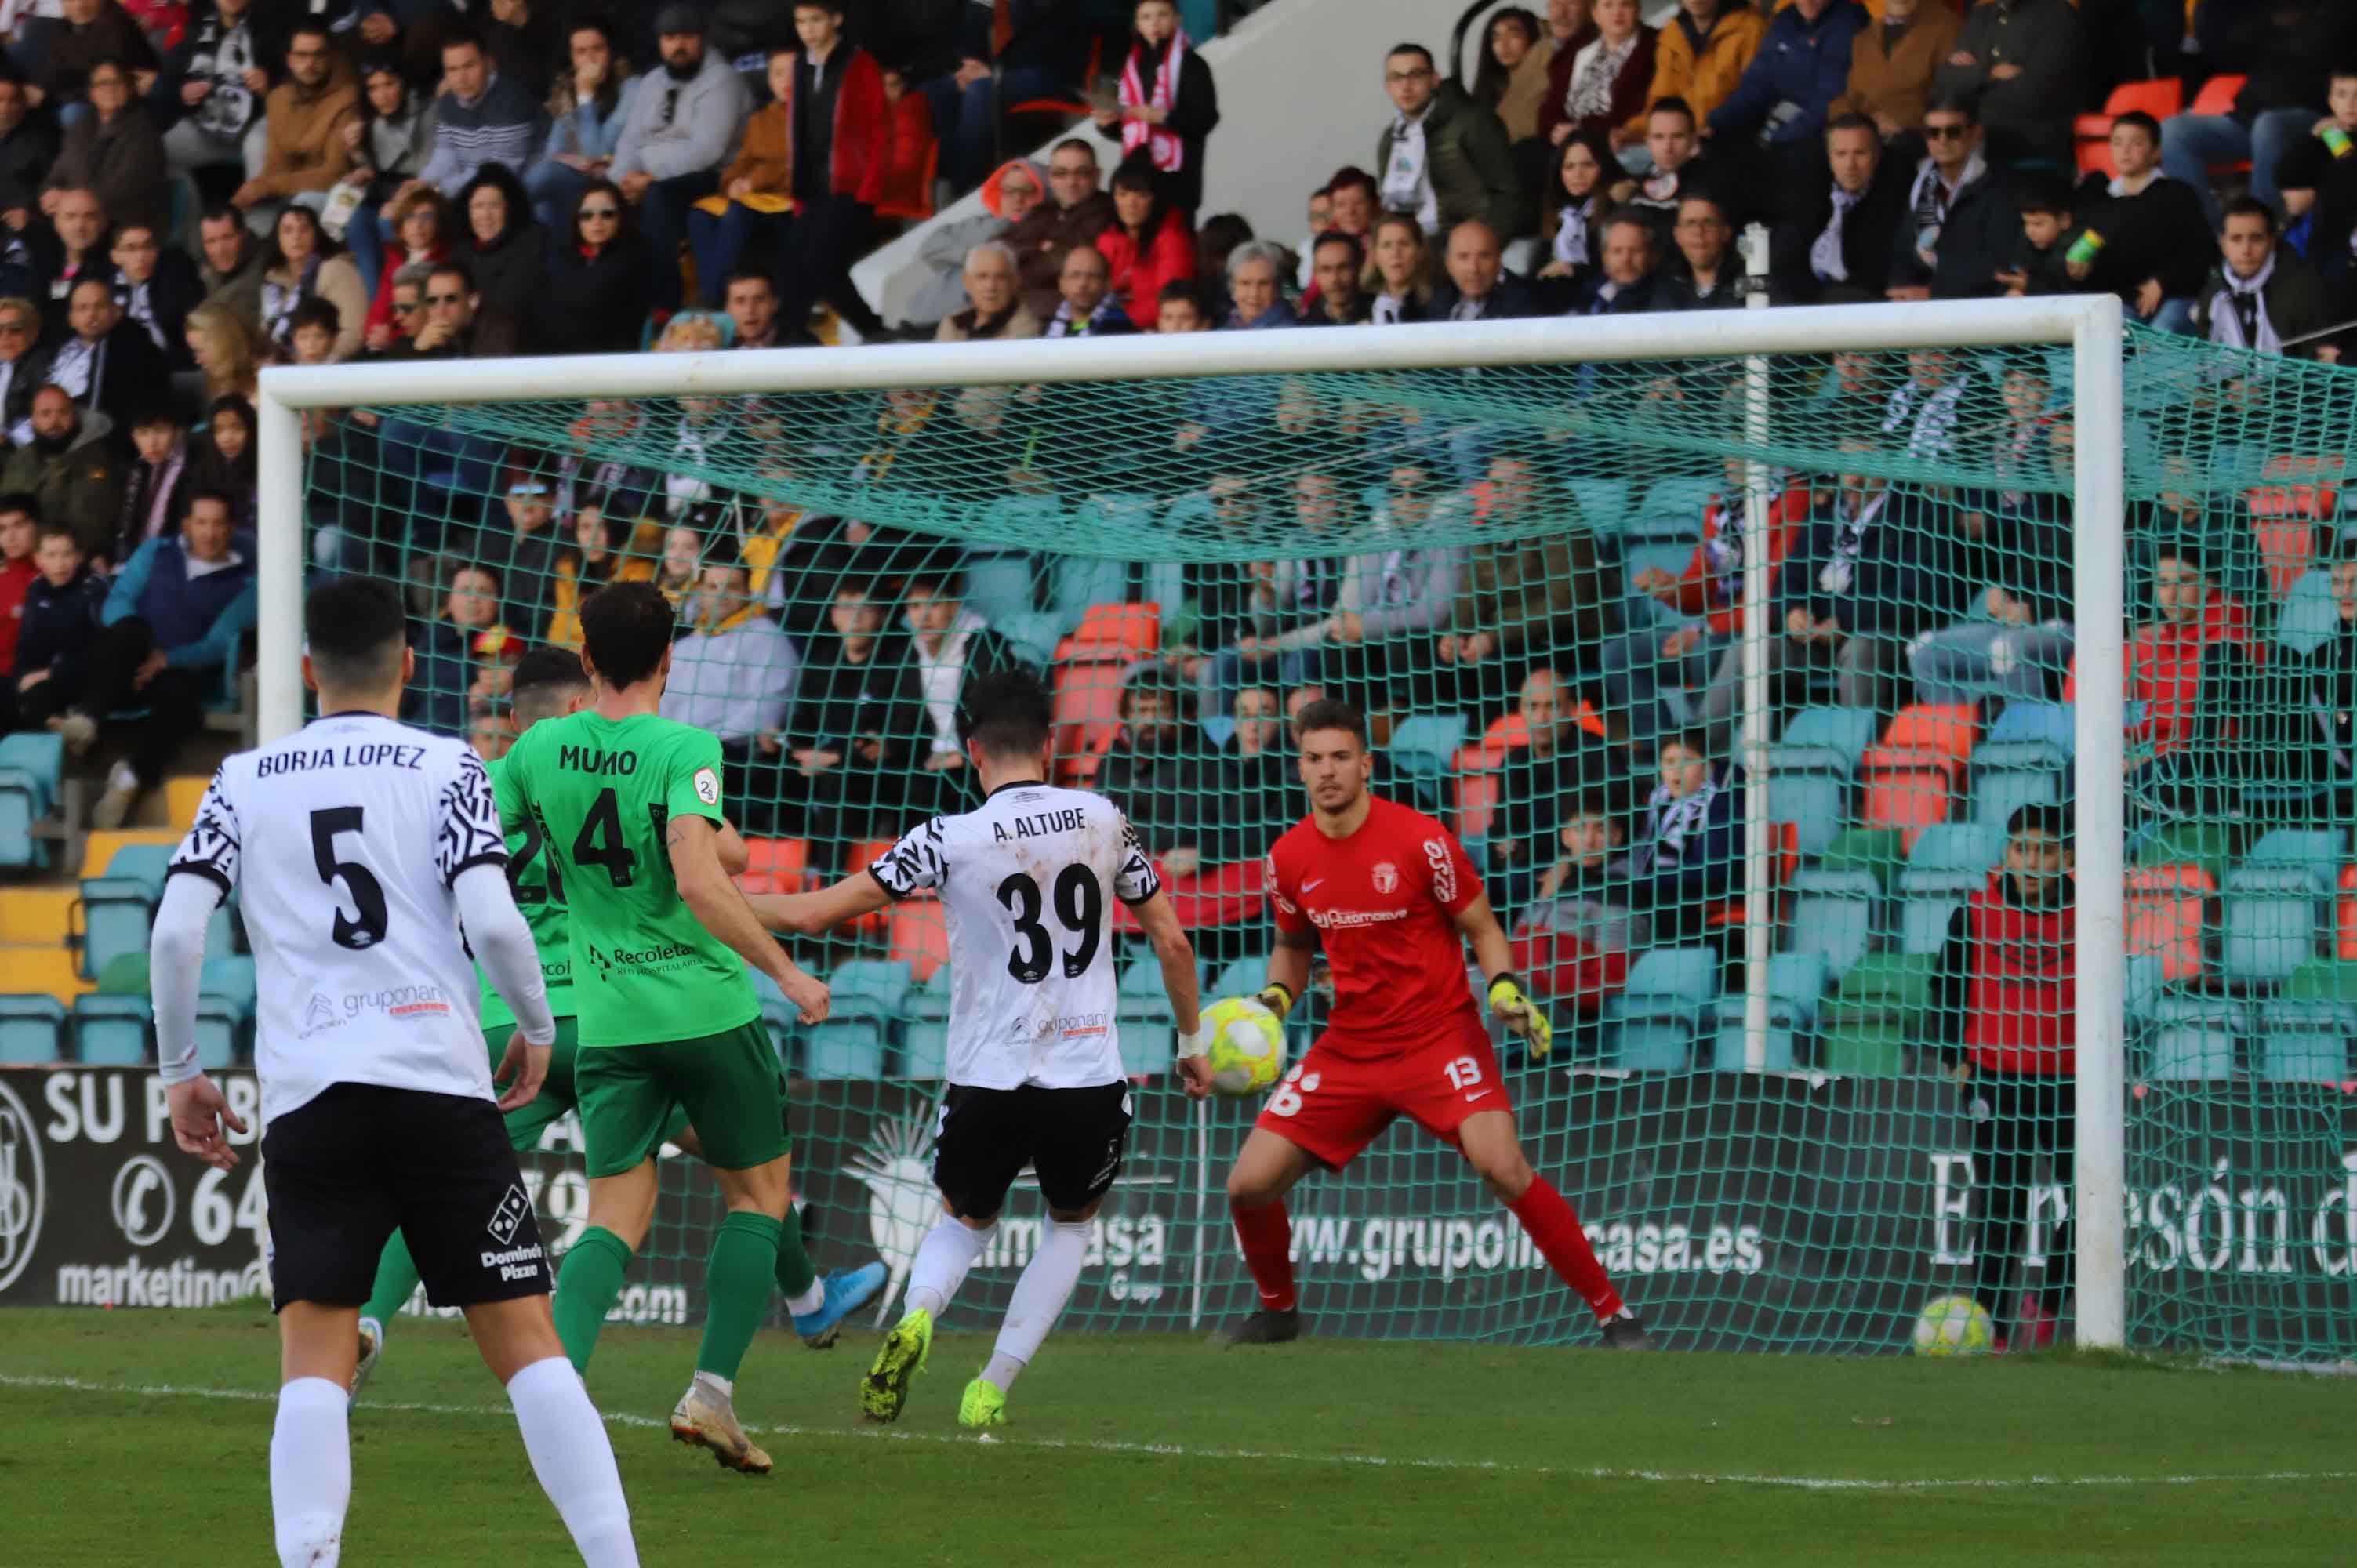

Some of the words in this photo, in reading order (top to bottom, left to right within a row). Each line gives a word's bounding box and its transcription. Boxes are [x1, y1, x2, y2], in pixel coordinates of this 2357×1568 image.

[257, 749, 335, 779] BORJA
[343, 743, 427, 771] LOPEZ
[572, 786, 637, 888] 4
[993, 822, 1013, 844] A.
[1015, 808, 1086, 840] ALTUBE
[309, 806, 388, 951] 5
[996, 862, 1102, 985] 39
[1444, 1057, 1482, 1091] 13
[45, 1071, 124, 1143] SU
[500, 1264, 539, 1282] Pizza
